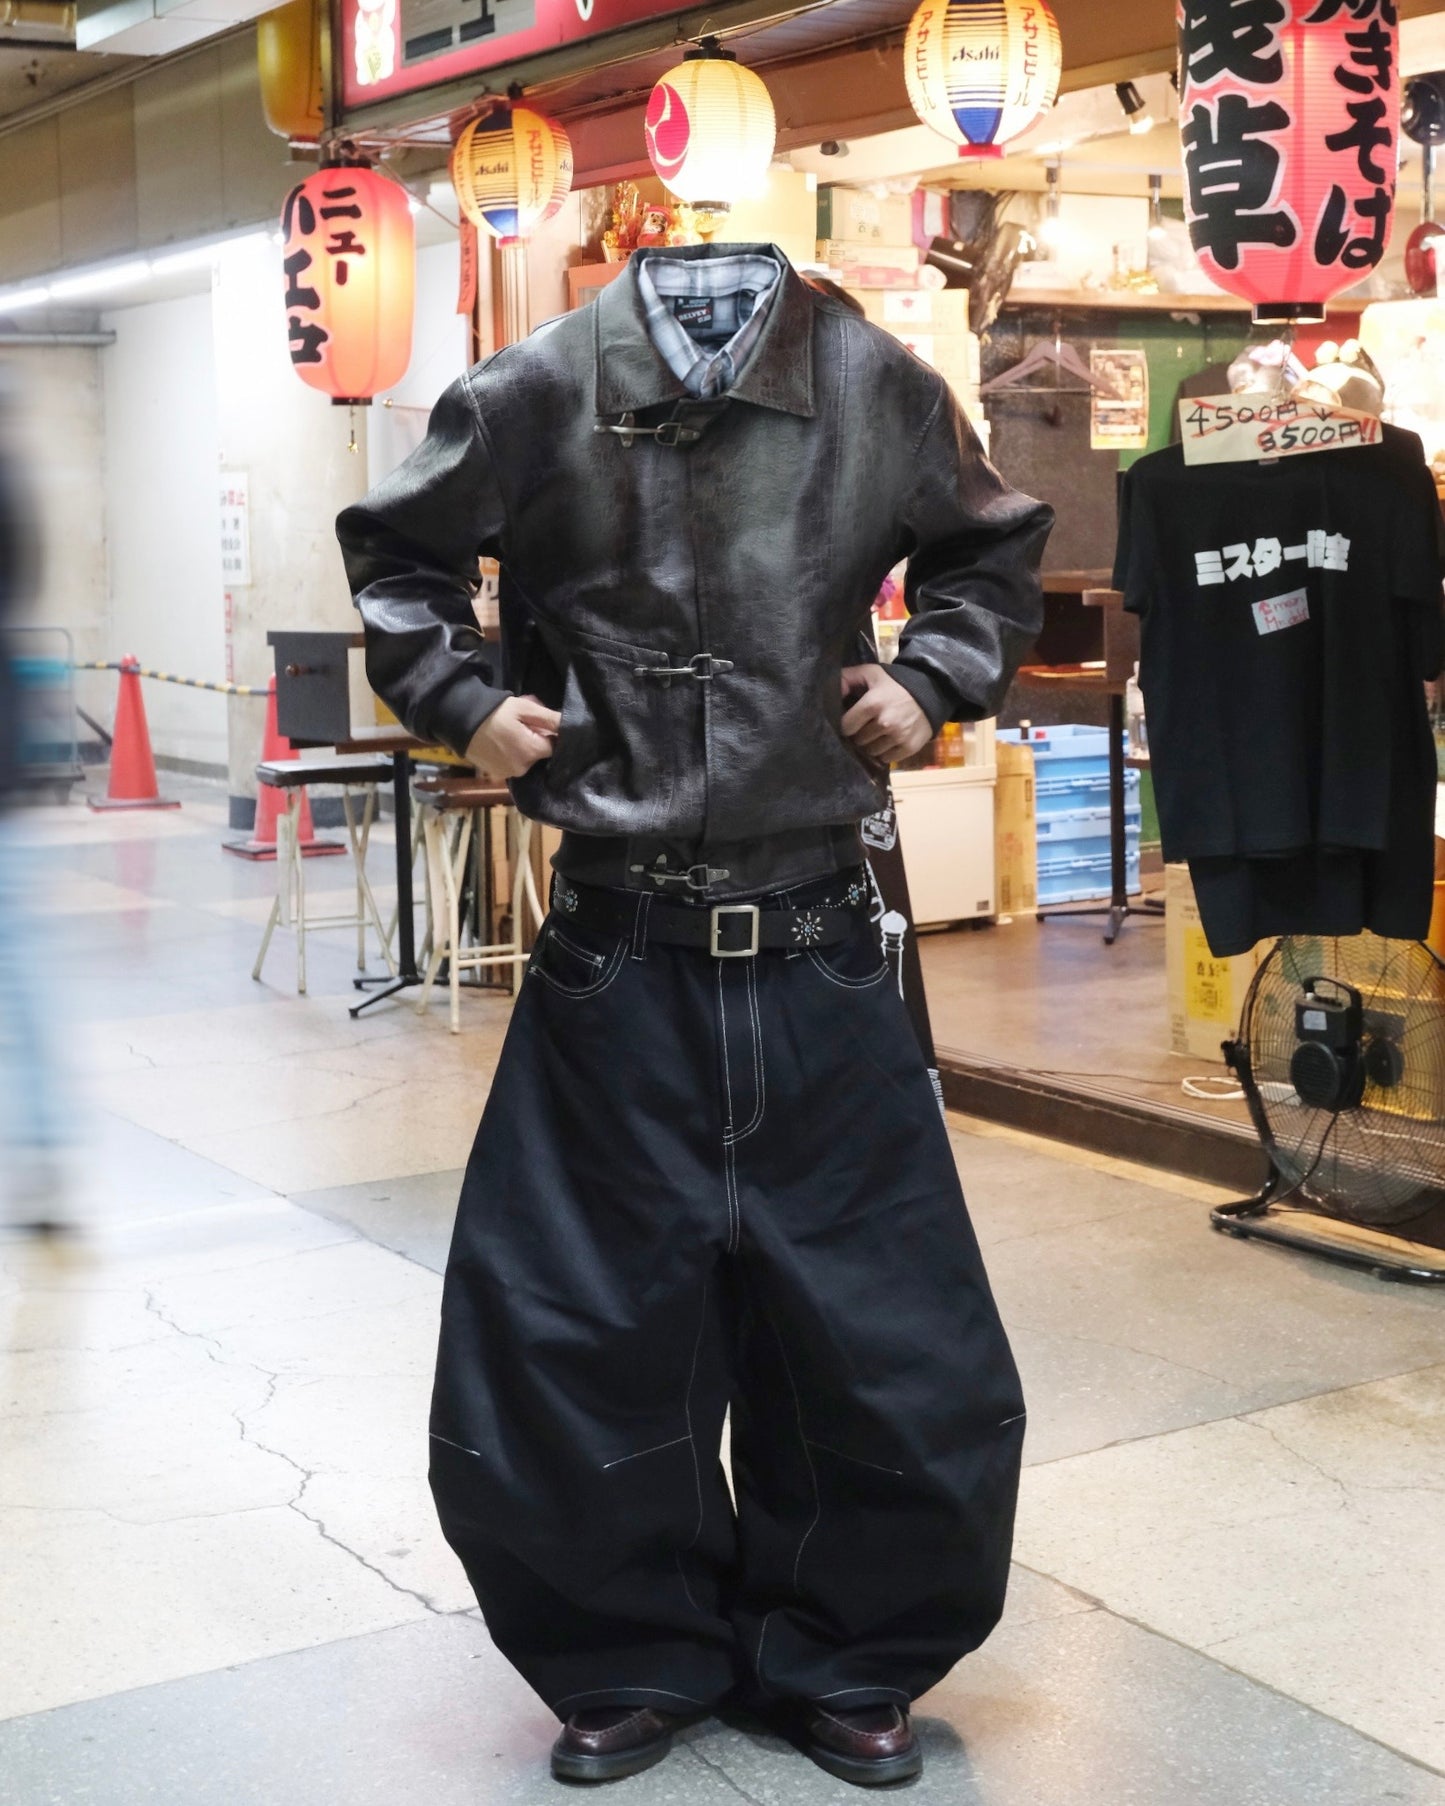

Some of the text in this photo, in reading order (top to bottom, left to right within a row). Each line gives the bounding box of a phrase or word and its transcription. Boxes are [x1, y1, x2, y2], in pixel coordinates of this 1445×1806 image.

[916, 10, 936, 110] アサヒビール
[952, 45, 1000, 62] Asahi
[1014, 6, 1039, 107] アサヒビール
[474, 161, 509, 176] Asahi
[319, 186, 366, 286] ニュー
[1186, 400, 1299, 436] 4500円
